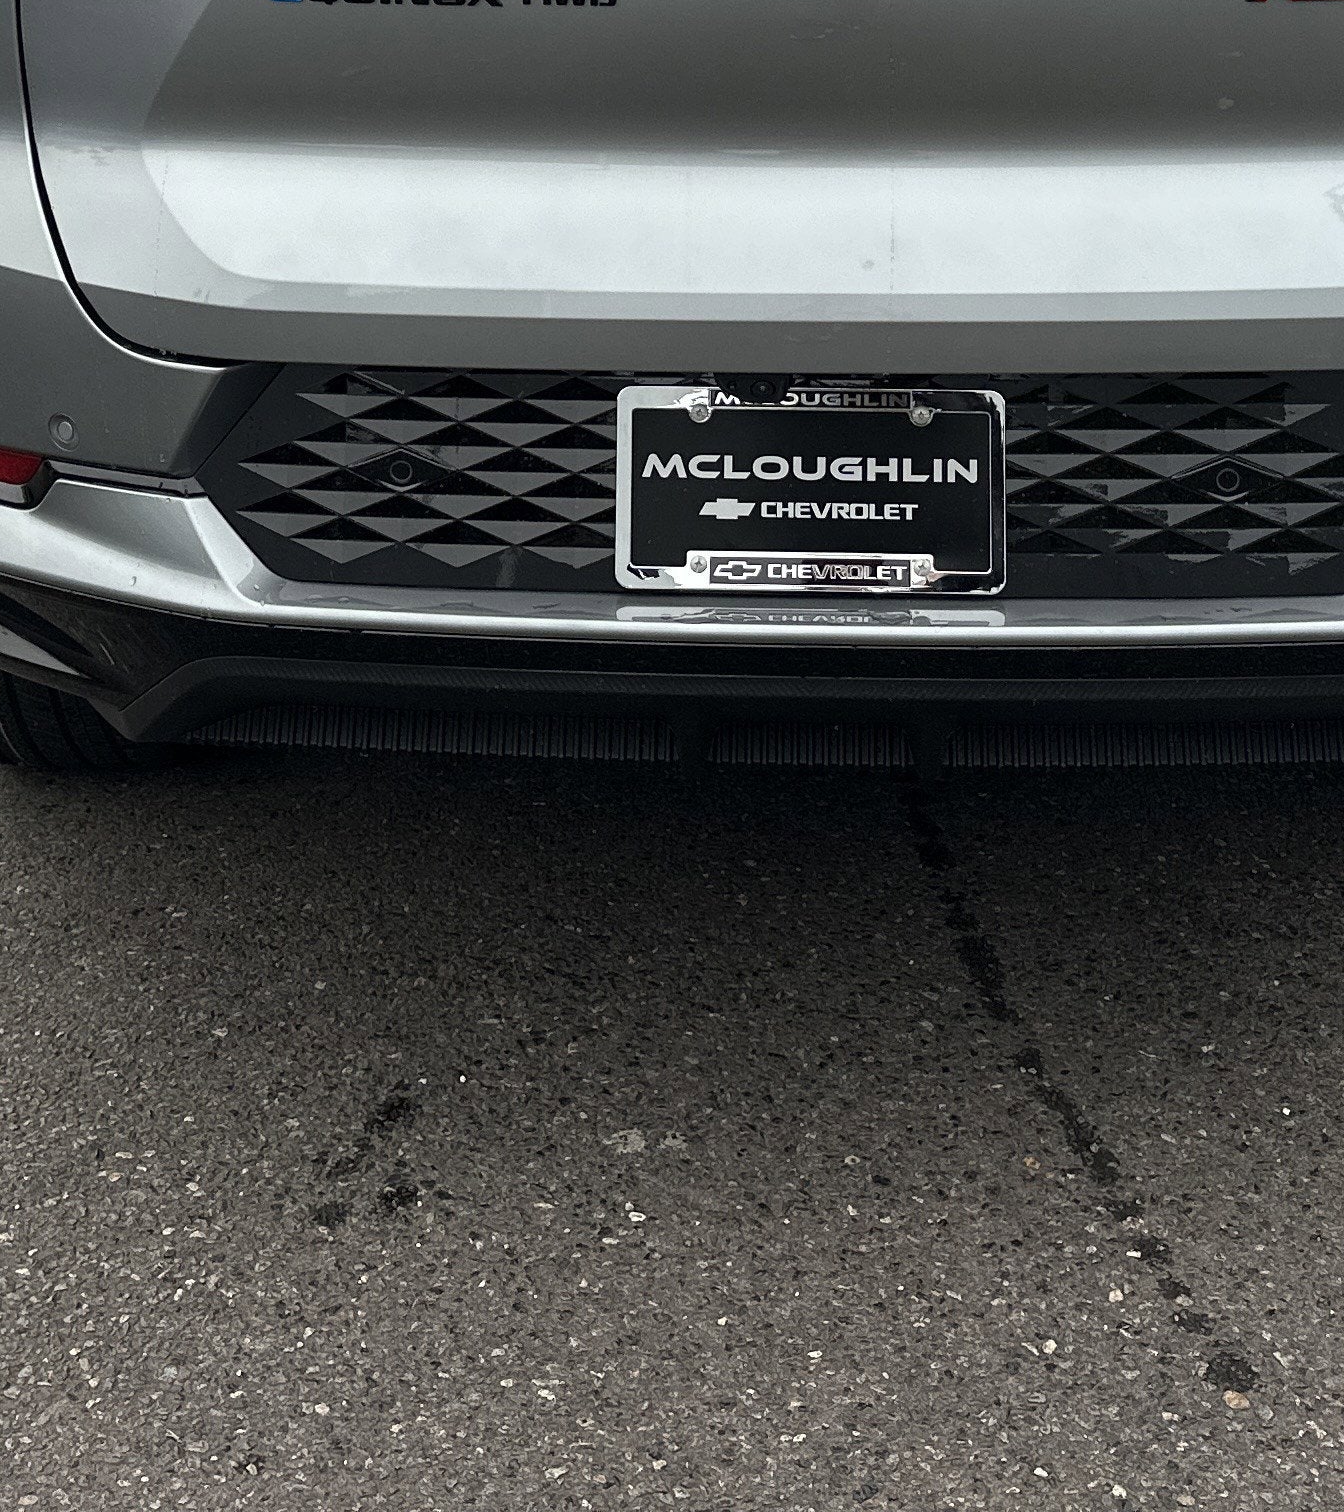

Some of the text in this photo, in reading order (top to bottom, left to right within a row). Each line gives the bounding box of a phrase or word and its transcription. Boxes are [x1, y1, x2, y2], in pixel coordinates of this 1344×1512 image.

[642, 453, 978, 484] MCLOUGHLIN
[760, 501, 919, 520] CHEVROLET
[767, 563, 907, 581] CHEVROLET
